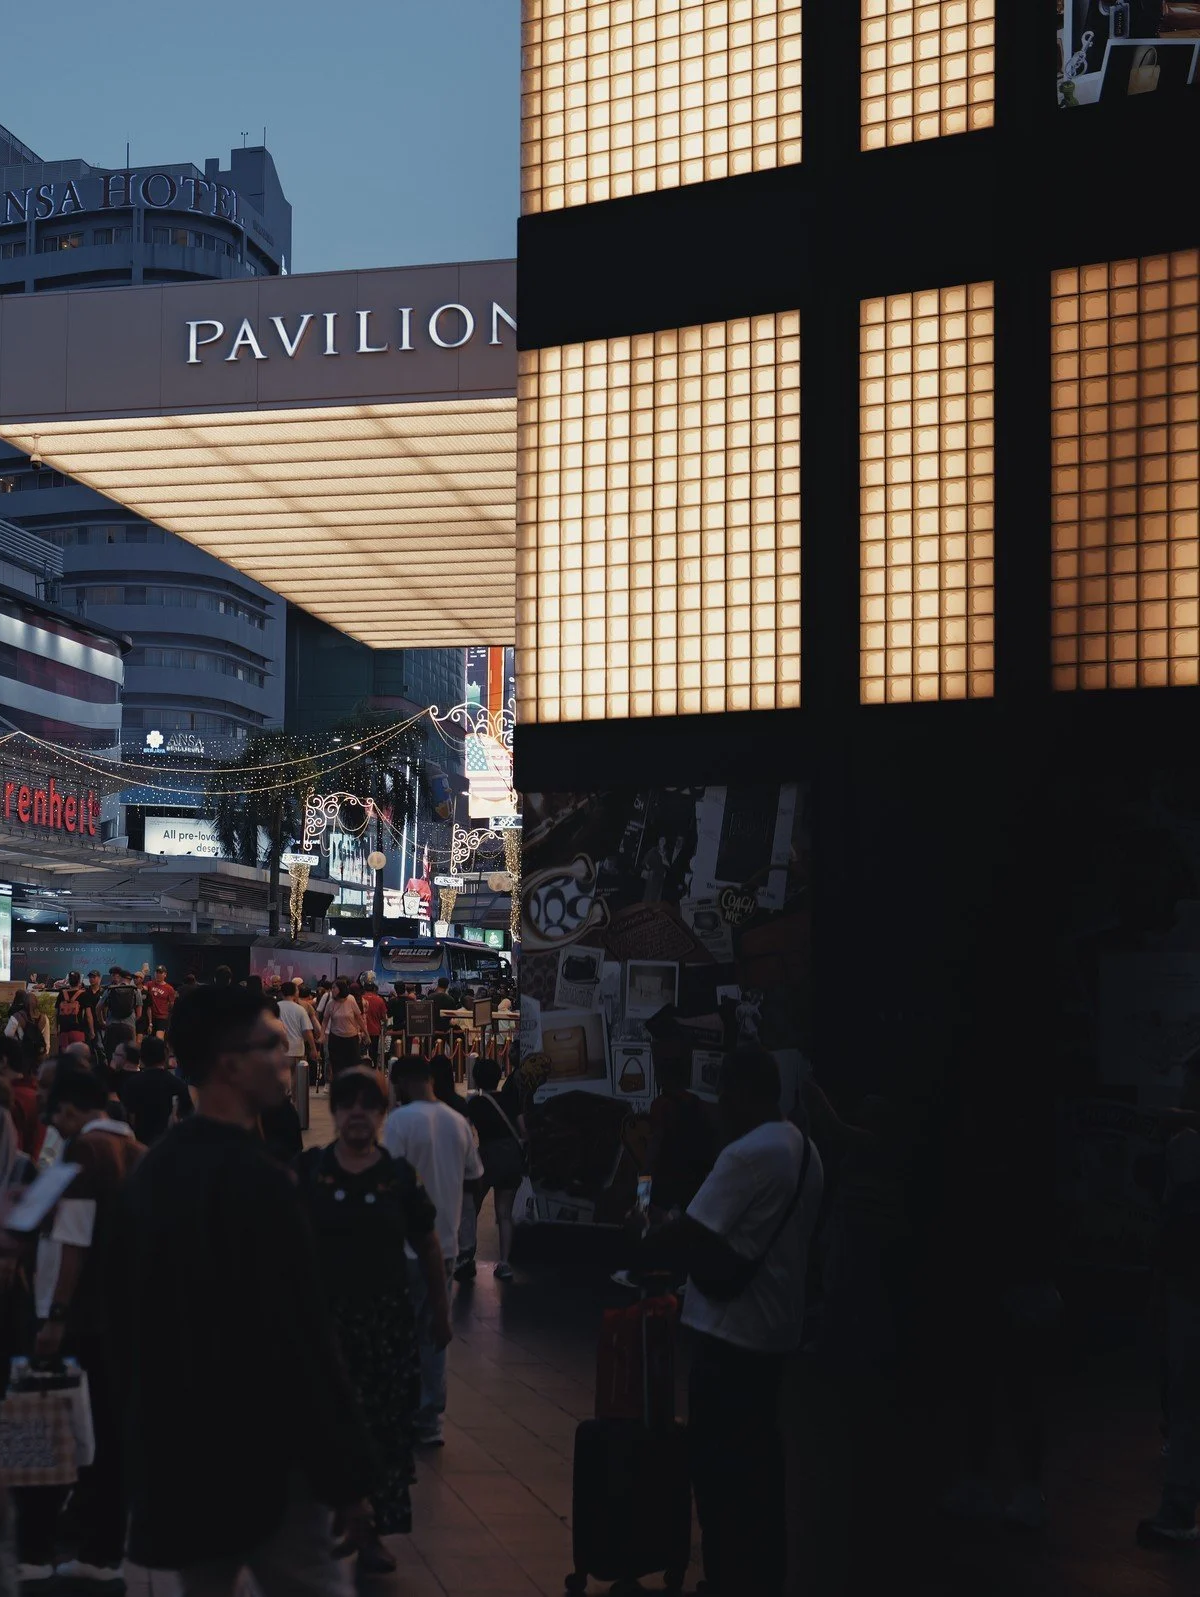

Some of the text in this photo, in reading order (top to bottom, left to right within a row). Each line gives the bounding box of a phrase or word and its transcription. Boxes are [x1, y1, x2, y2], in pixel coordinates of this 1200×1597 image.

[99, 173, 246, 228] HOTEL
[186, 301, 517, 365] PAVILION
[163, 829, 176, 839] All
[721, 888, 756, 914] COACH
